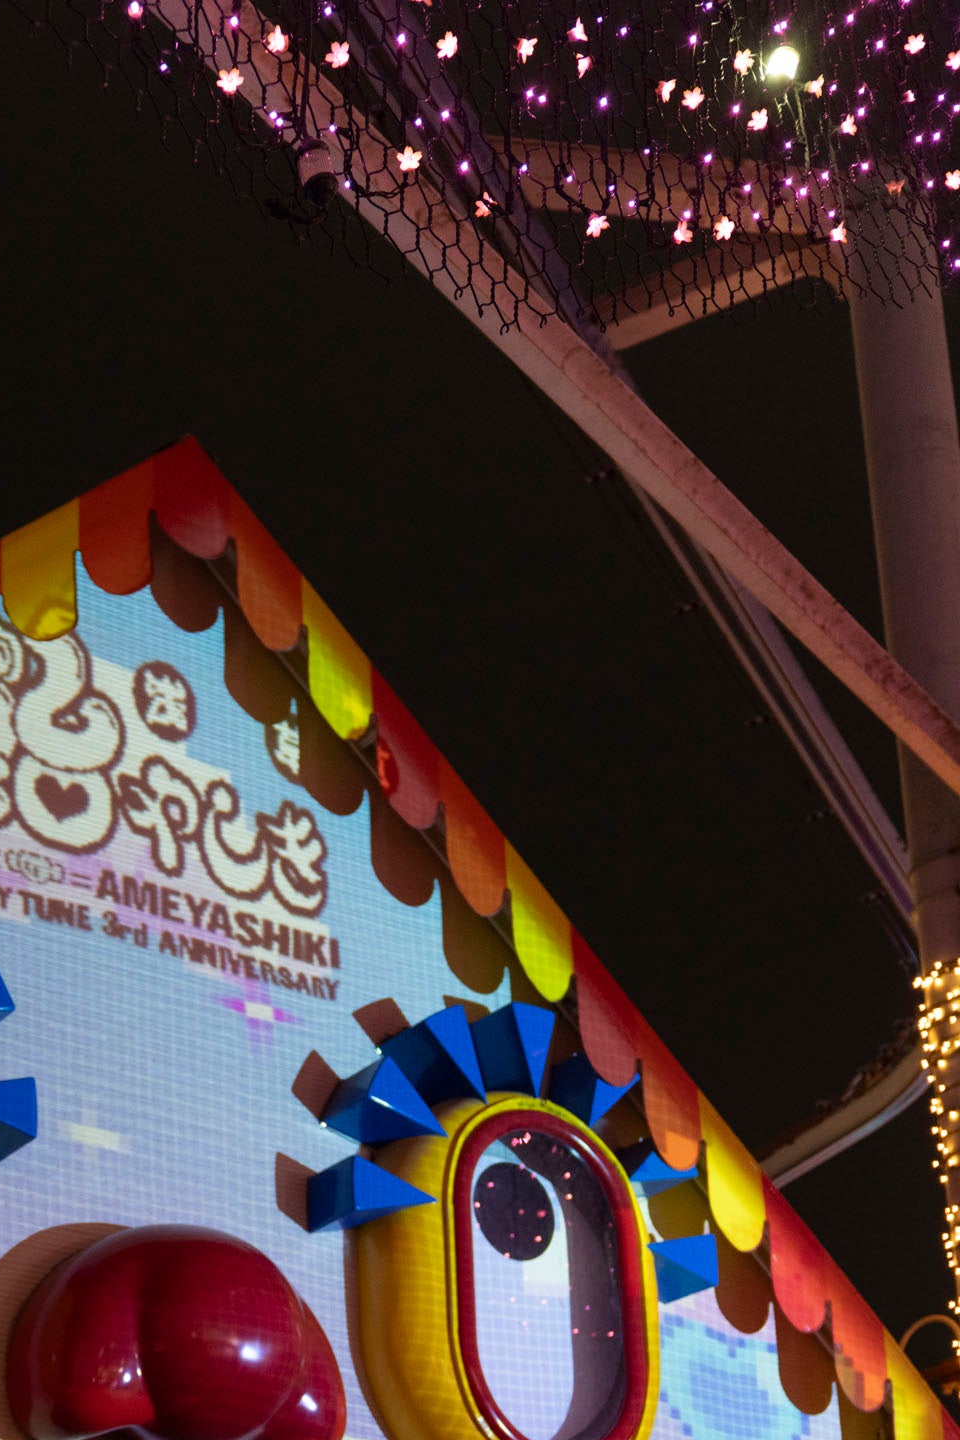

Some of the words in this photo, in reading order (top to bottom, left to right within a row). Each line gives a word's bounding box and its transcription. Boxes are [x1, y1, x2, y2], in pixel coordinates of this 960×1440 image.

[18, 889, 92, 931] TUNE
[101, 909, 149, 949] 3rd
[158, 929, 340, 1001] ANNIVERSARY
[95, 868, 340, 970] AMEYASHIKI
